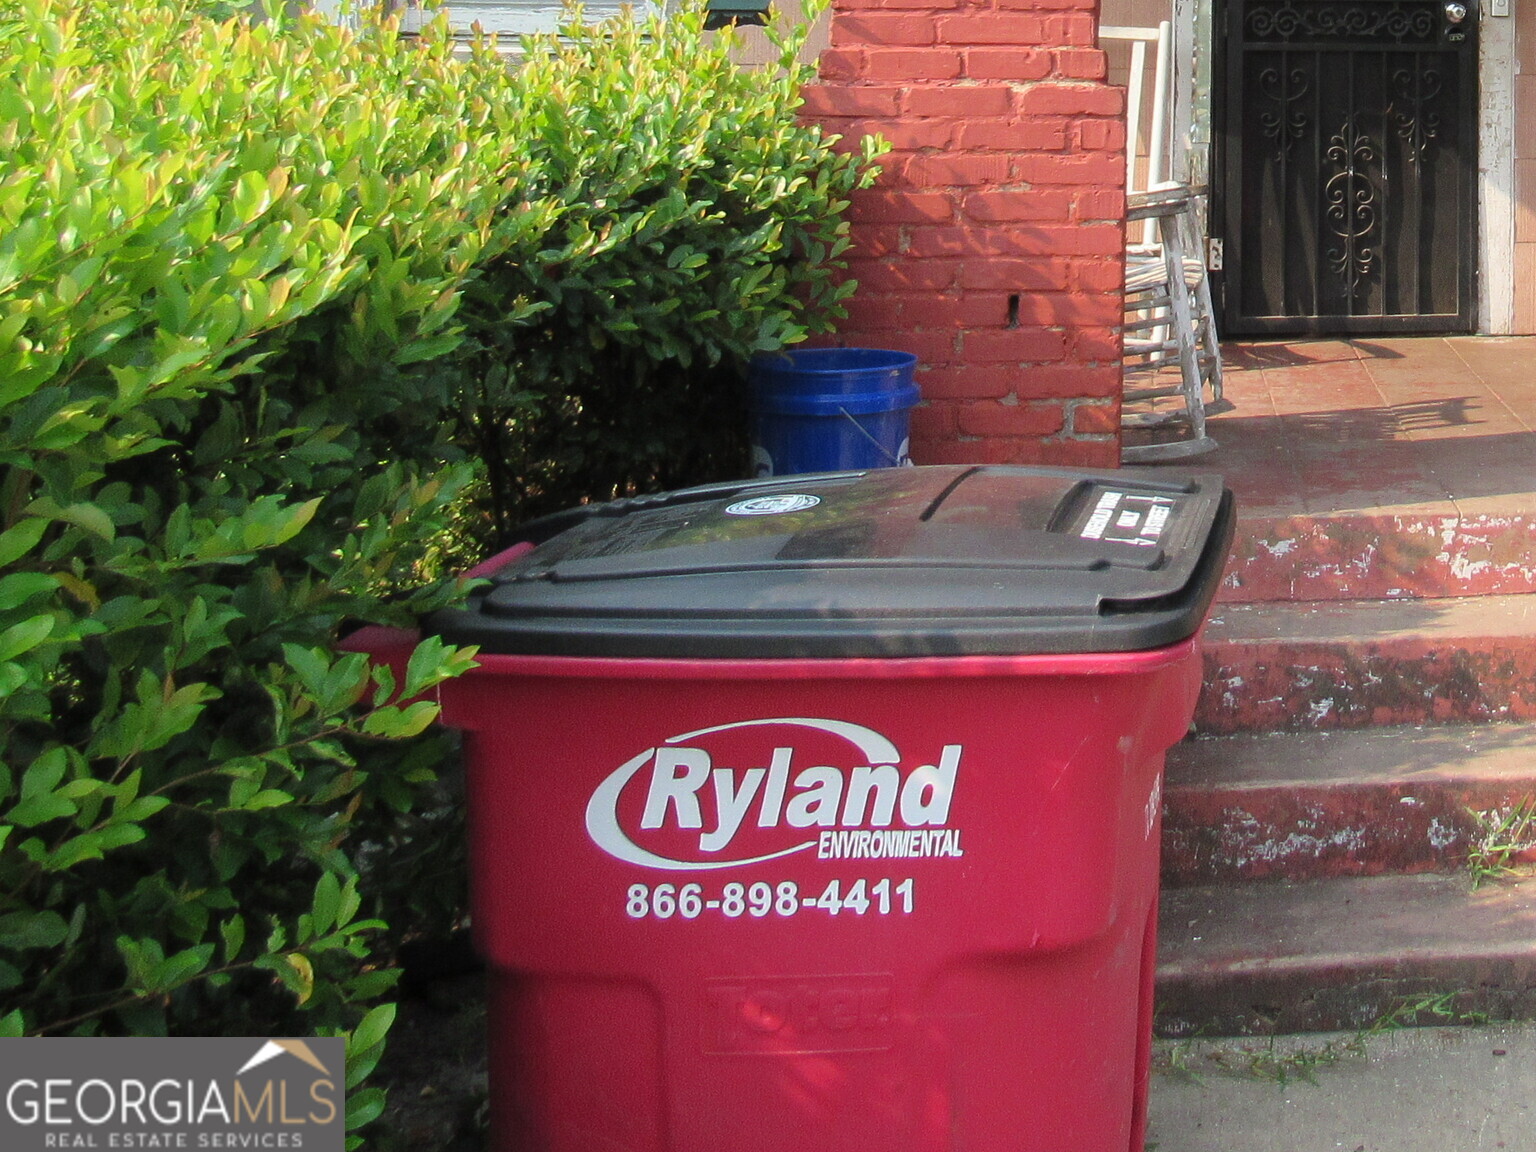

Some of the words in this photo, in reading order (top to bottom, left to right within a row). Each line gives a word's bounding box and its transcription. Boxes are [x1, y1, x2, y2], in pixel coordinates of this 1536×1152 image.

[641, 745, 963, 851] Ryland
[817, 828, 964, 859] ENVIRONMENTAL
[625, 878, 916, 919] 866-898-4411
